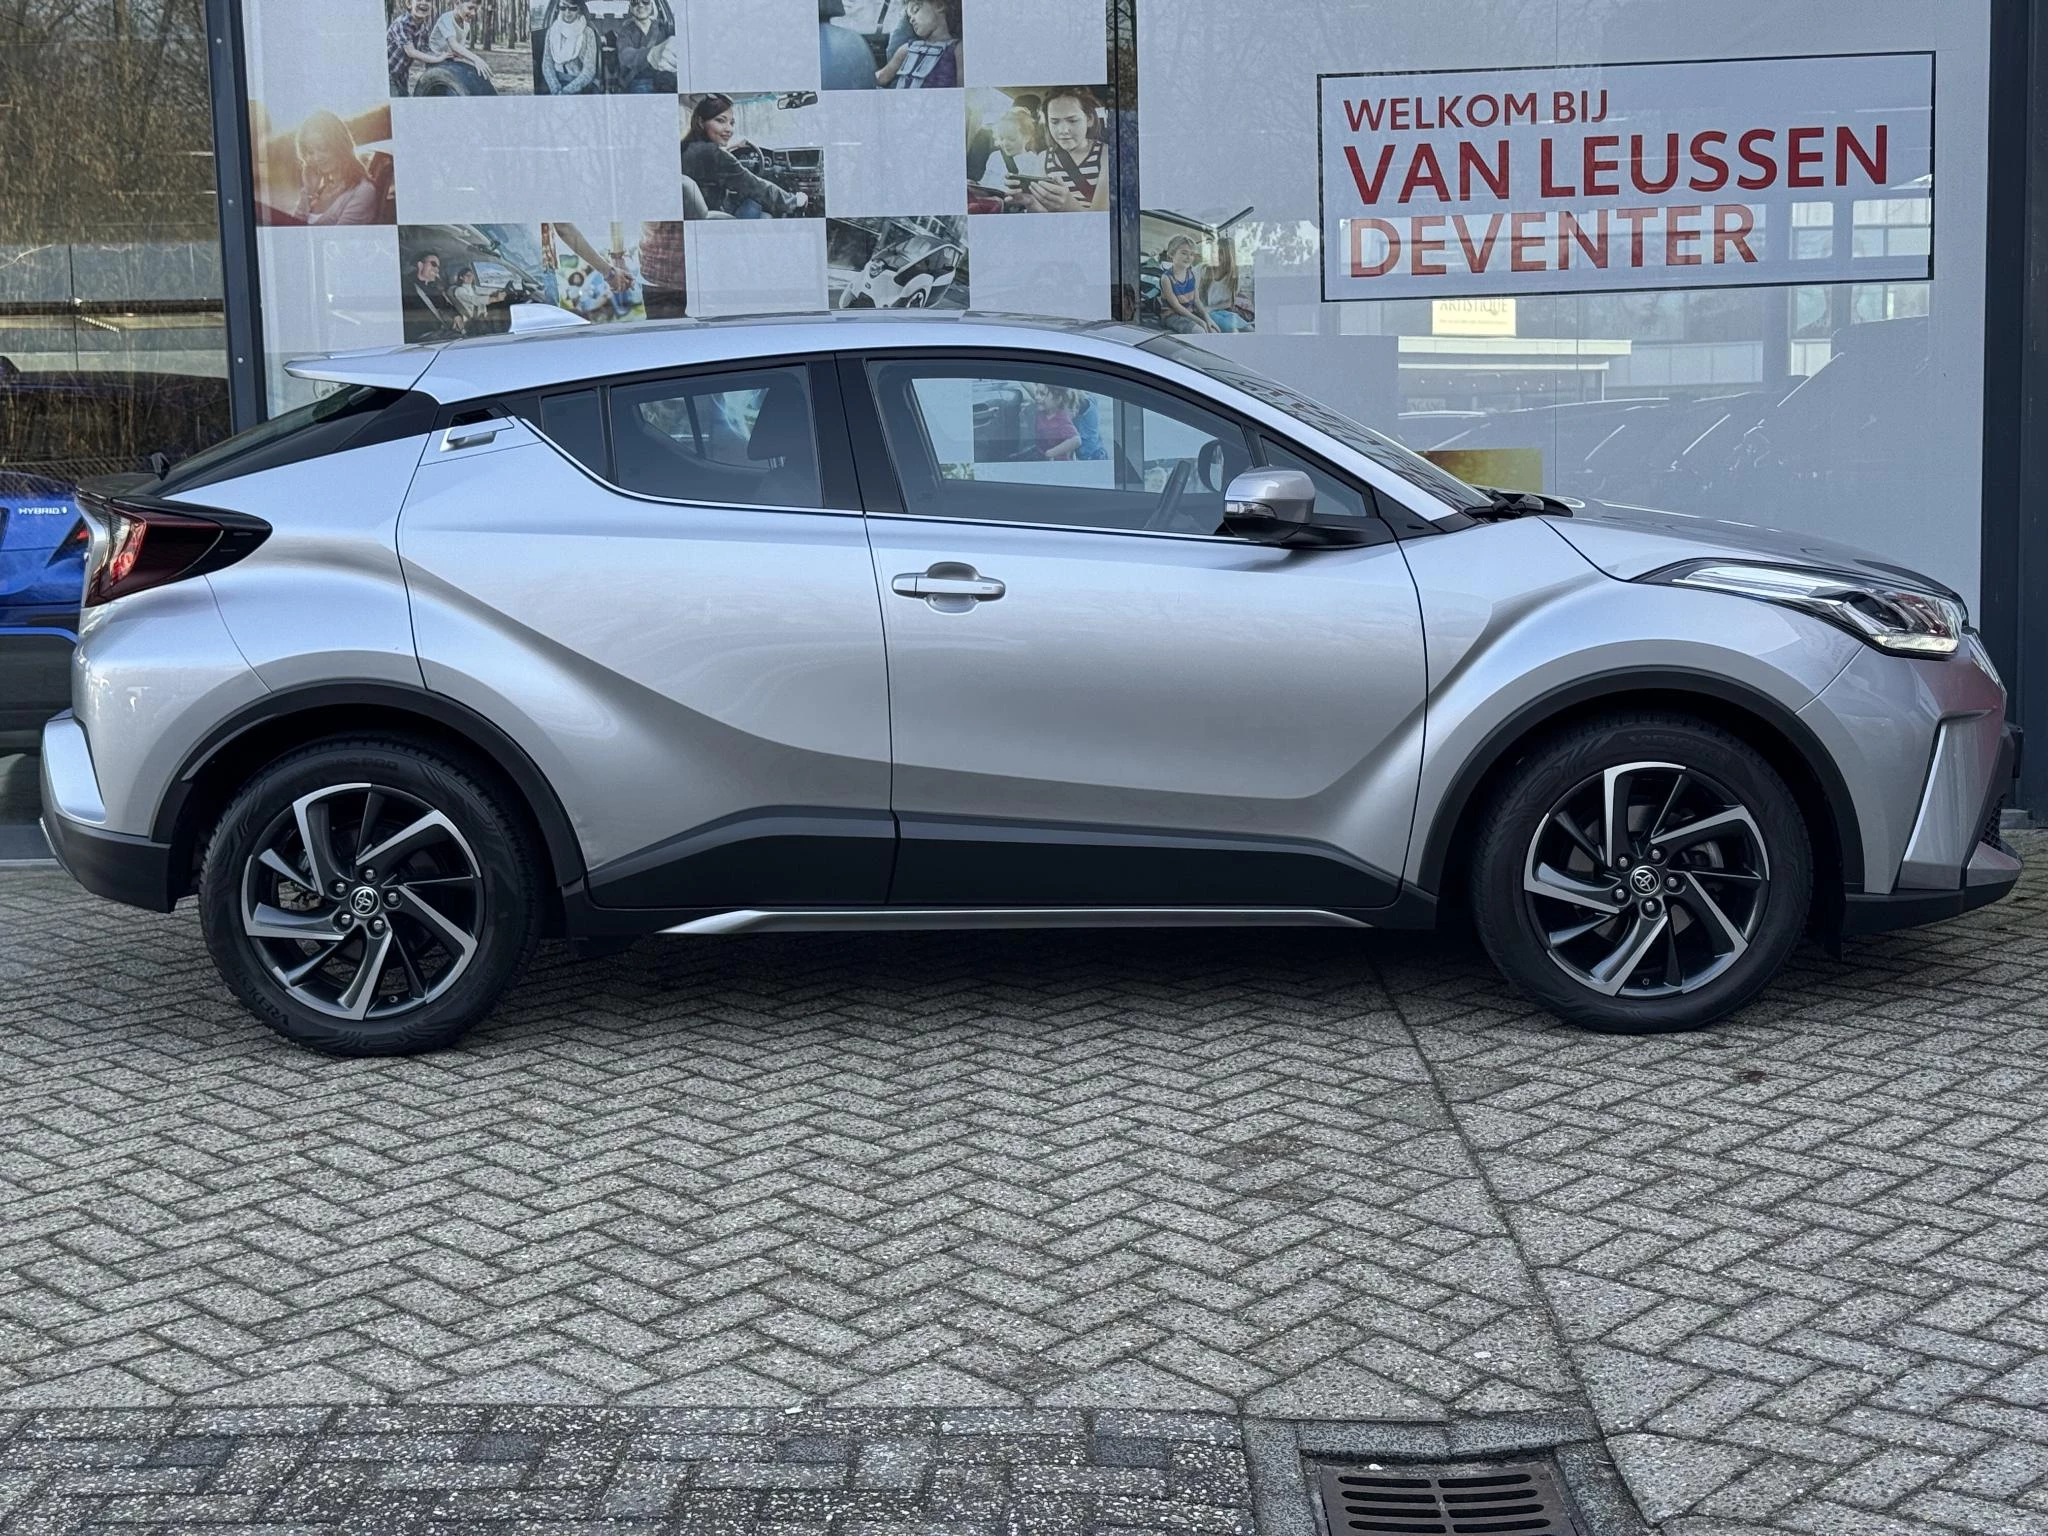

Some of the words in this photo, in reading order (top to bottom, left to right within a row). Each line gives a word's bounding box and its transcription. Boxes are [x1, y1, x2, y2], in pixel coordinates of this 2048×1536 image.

[1344, 93, 1538, 131] WELKOM
[1553, 90, 1608, 125] BIJ
[1343, 140, 1510, 205] VAN
[1541, 124, 1888, 198] LEUSSEN
[1349, 203, 1758, 279] DEVENTER
[18, 507, 60, 515] HYBRID
